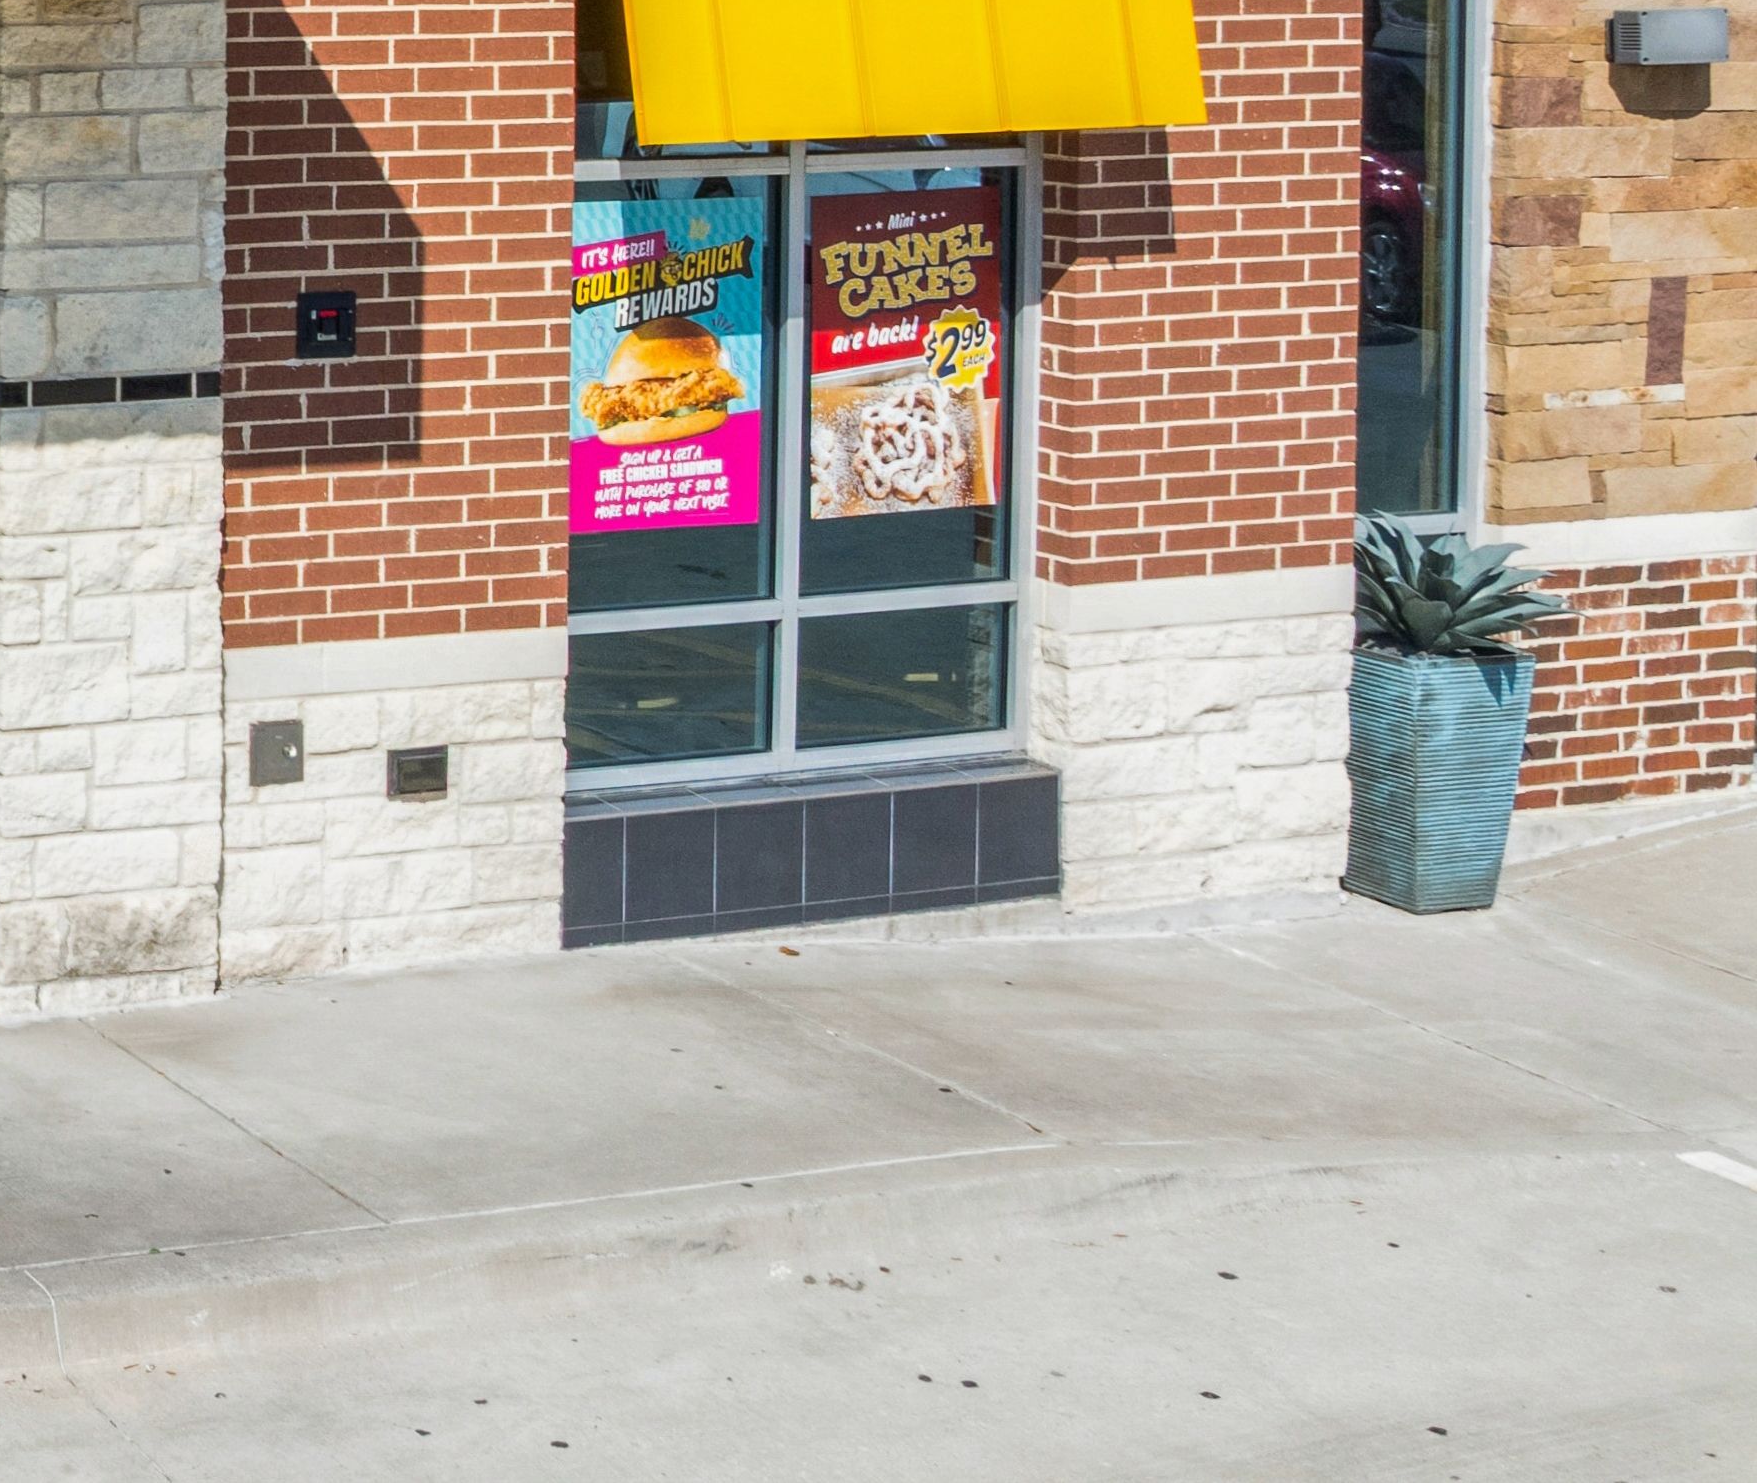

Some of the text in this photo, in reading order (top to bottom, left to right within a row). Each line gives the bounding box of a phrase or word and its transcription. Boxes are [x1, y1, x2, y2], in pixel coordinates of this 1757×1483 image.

[888, 211, 917, 230] Mini
[581, 246, 608, 269] IT'S
[820, 223, 993, 285] FUNNEL
[575, 240, 746, 306] GOLDEN CHICK
[839, 260, 977, 317] CAKES
[614, 277, 717, 328] REWARDS
[831, 315, 919, 354] are back!
[962, 354, 985, 366] EACH
[647, 449, 662, 463] UP
[599, 459, 723, 485] FREE CHICKEN SANDWICH
[625, 482, 676, 500] PURCHASE
[678, 479, 694, 494] OF
[714, 476, 728, 490] OR
[594, 504, 622, 519] MORE
[625, 502, 641, 517] ON
[673, 496, 701, 510] NEXT
